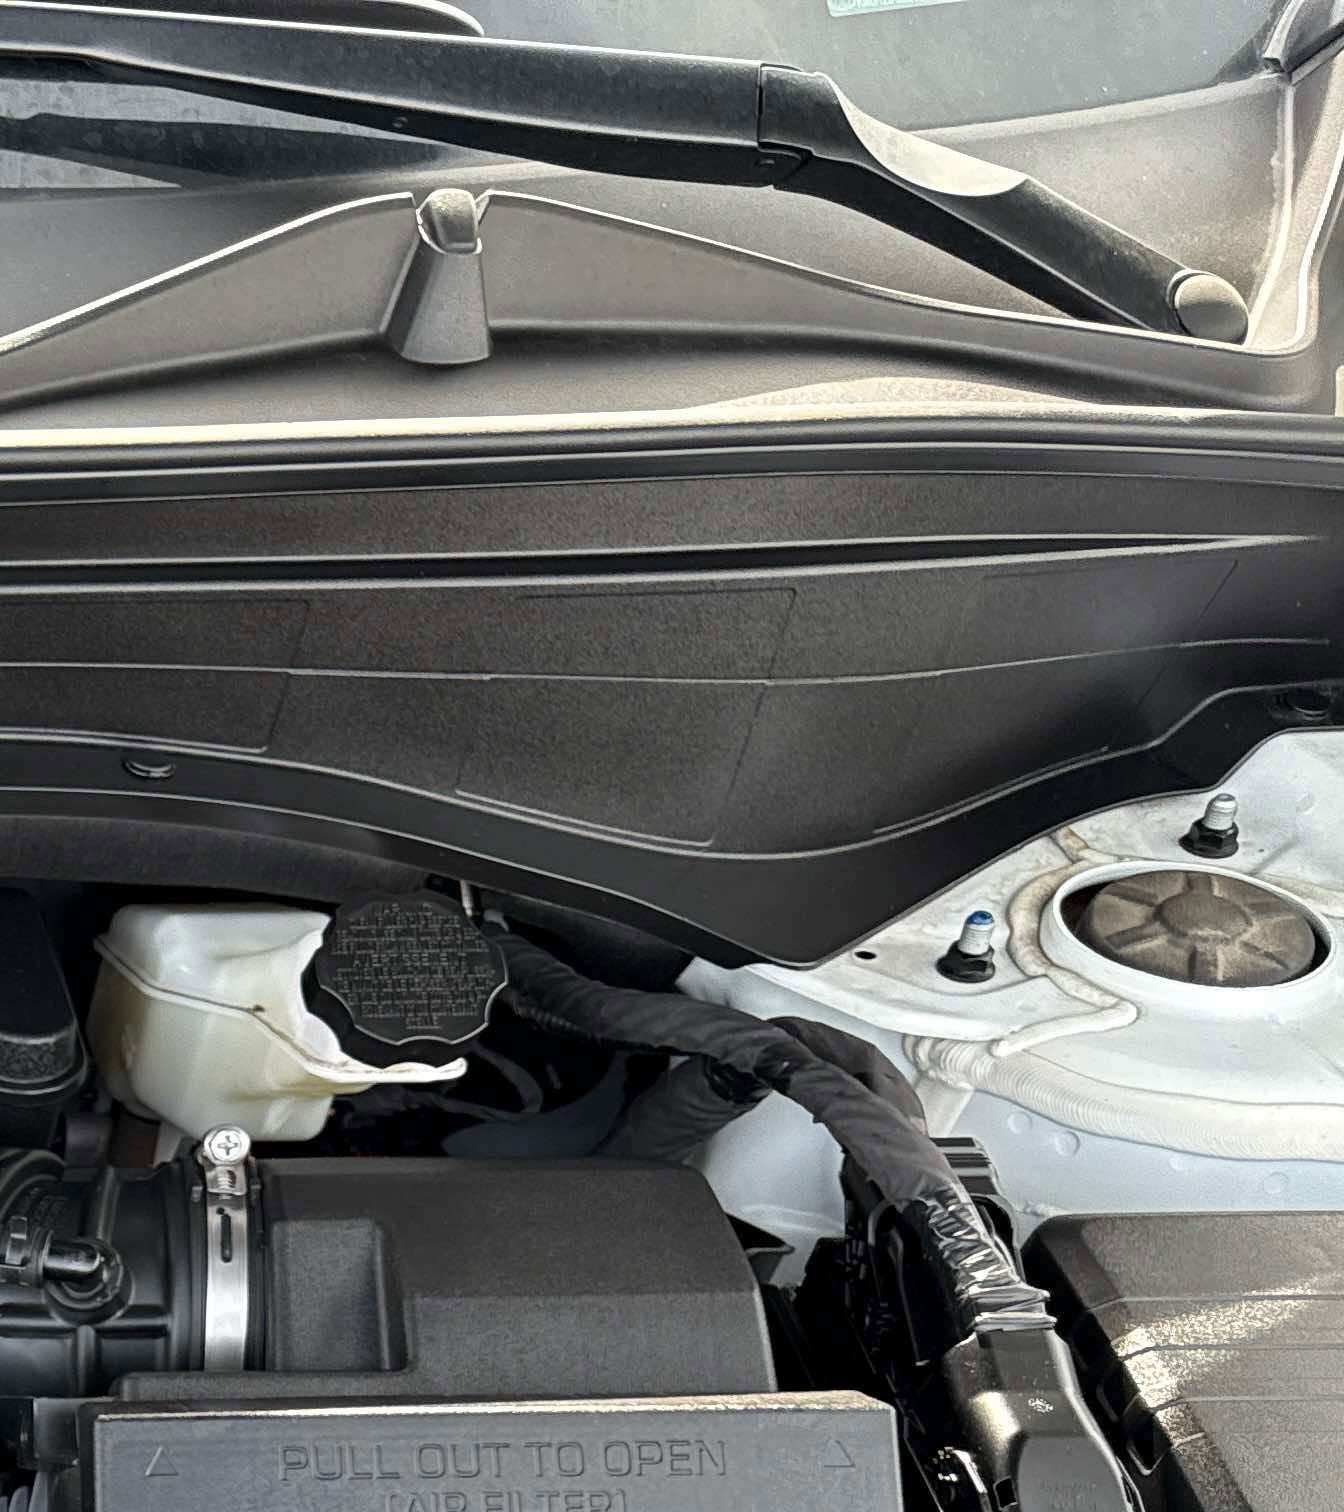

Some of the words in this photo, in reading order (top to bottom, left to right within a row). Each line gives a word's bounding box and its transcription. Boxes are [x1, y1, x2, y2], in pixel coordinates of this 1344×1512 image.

[280, 1443, 401, 1481] PULL
[417, 1441, 511, 1478] OUT
[524, 1440, 586, 1477] TO
[603, 1438, 727, 1477] OPEN
